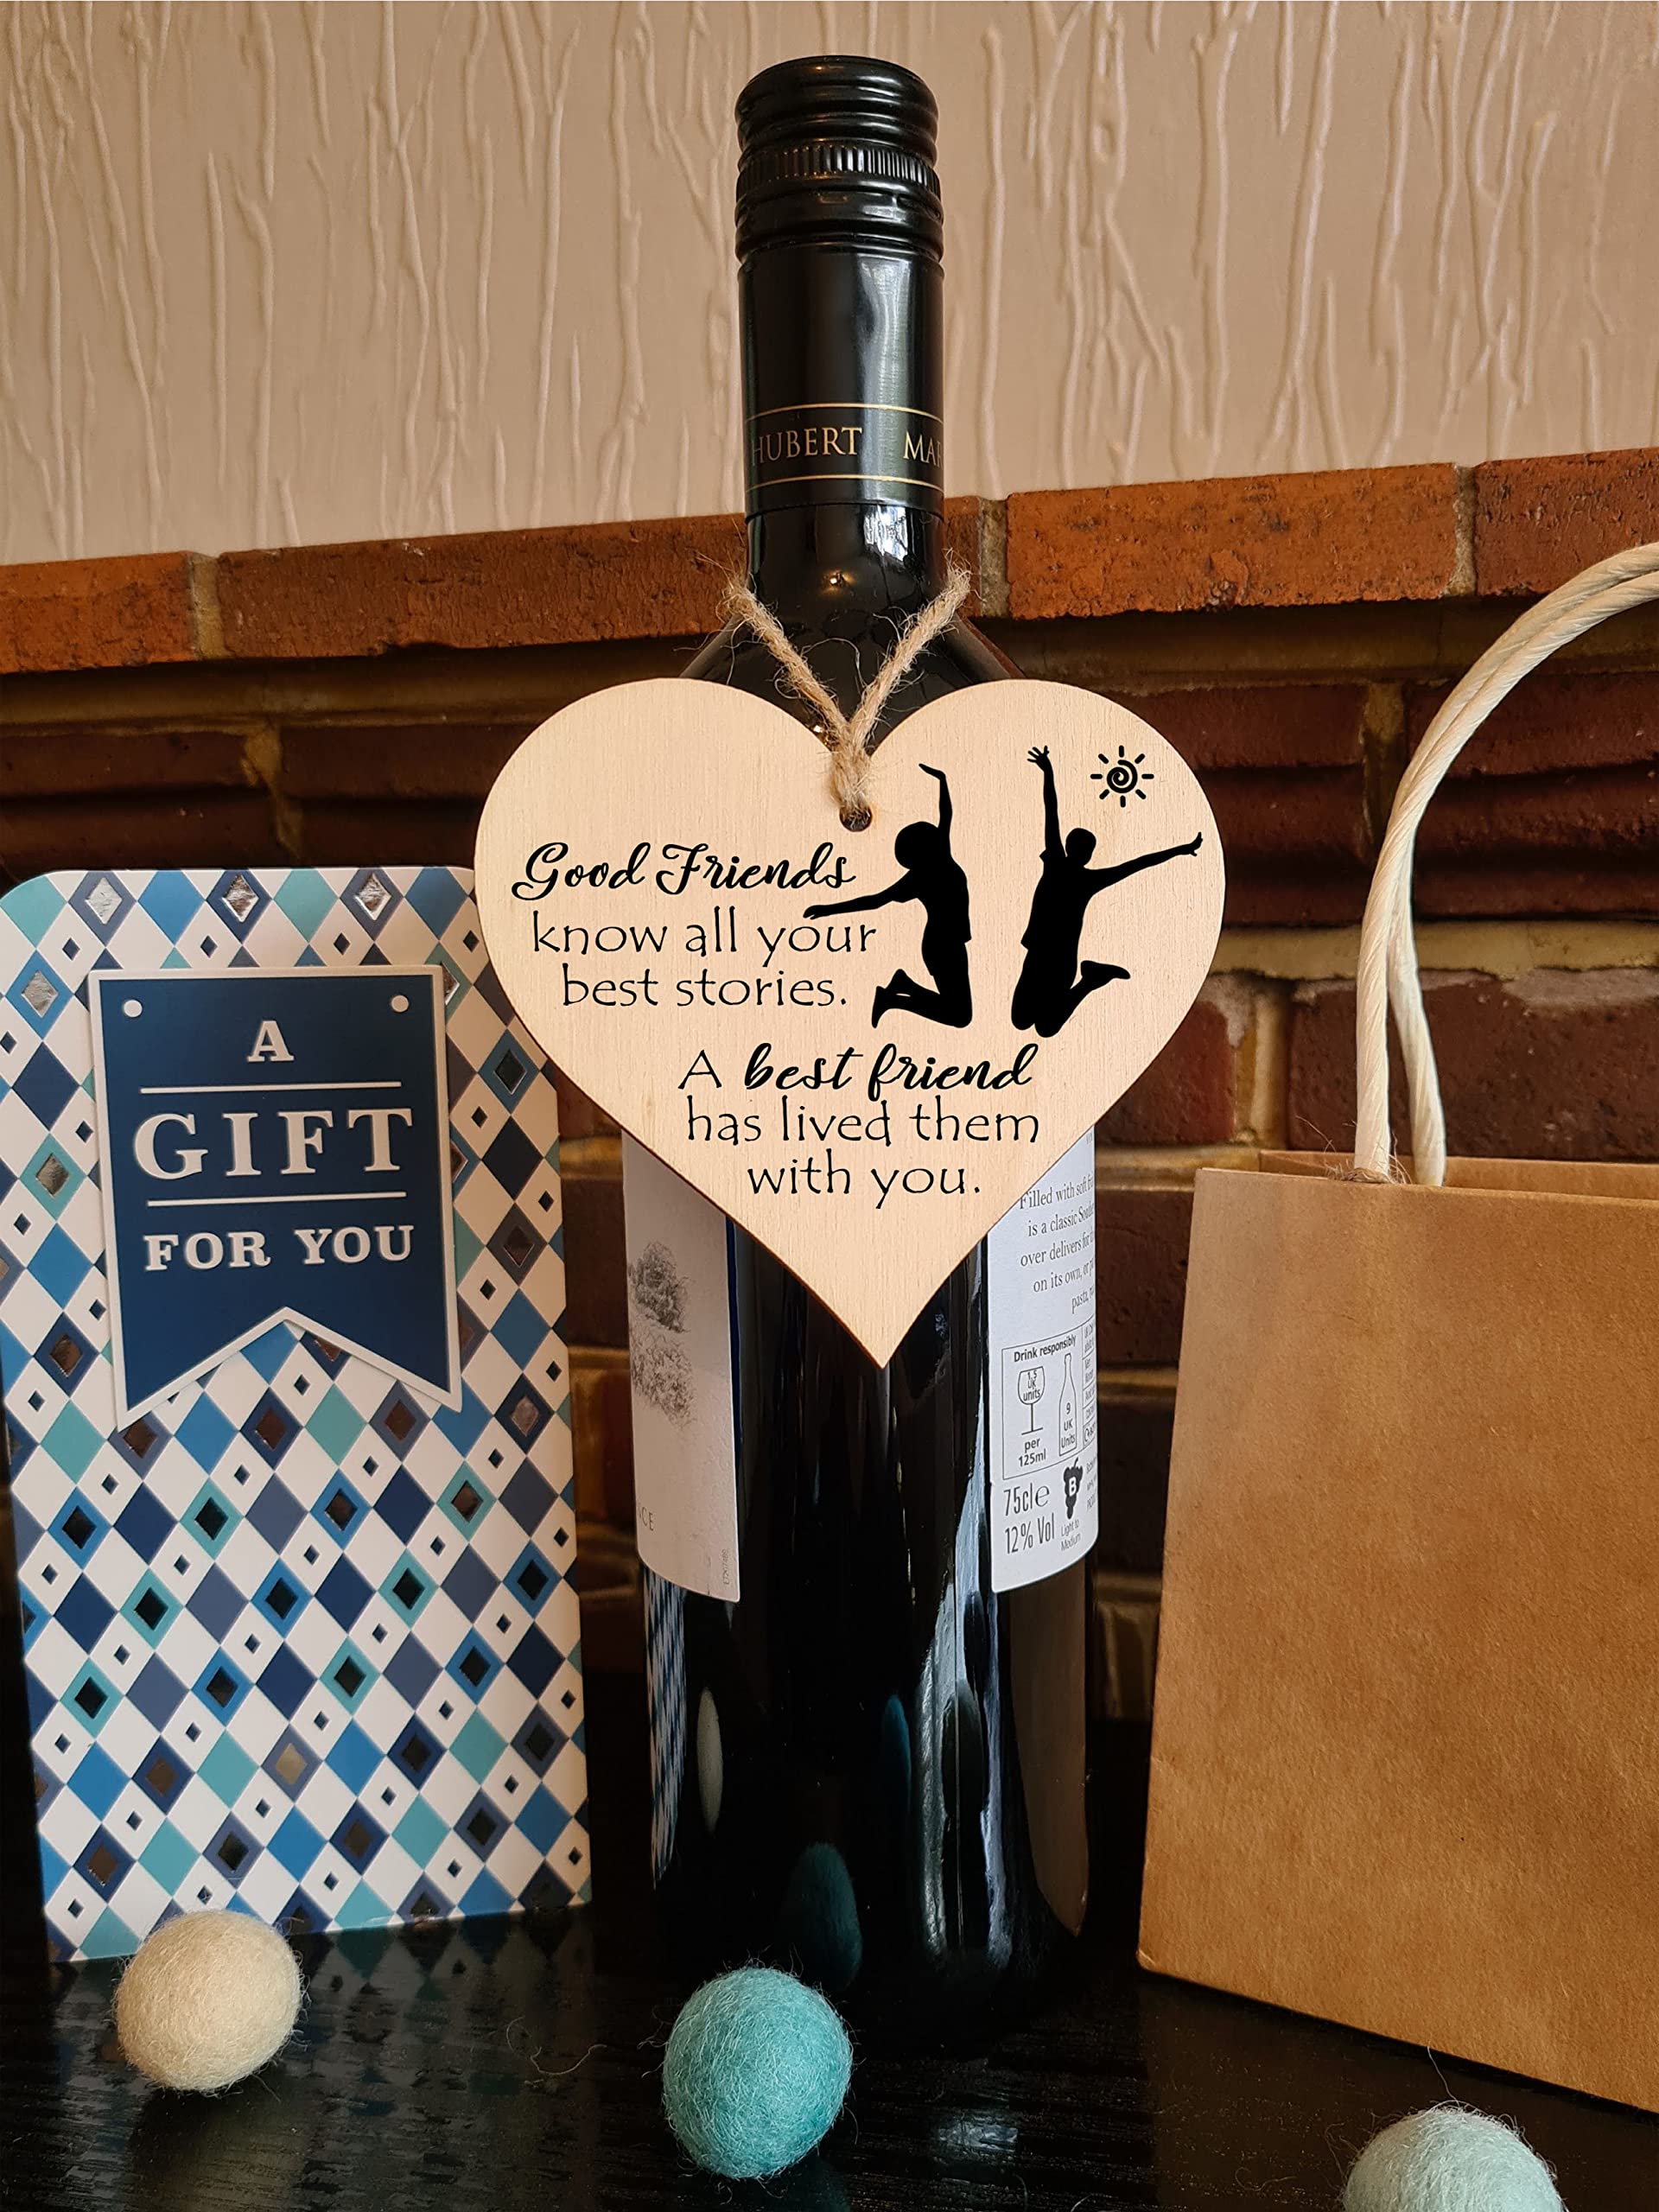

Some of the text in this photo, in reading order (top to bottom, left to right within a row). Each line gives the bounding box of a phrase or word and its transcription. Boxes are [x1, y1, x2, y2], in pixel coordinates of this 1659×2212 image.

[752, 426, 862, 467] HUBERT
[511, 842, 856, 900] Good Friends
[532, 906, 877, 967] know all your
[562, 963, 848, 1007] best stories.
[247, 1020, 295, 1062] A
[677, 1042, 1039, 1102] A best friend
[687, 1095, 1039, 1147] has lived them
[133, 1108, 413, 1180] GIFT
[747, 1147, 981, 1209] with you.
[1020, 1186, 1052, 1210] Filled
[1056, 1181, 1075, 1202] with
[1028, 1219, 1038, 1236] is
[1041, 1222, 1047, 1234] a
[1050, 1209, 1077, 1232] classic
[143, 1225, 415, 1271] FOR YOU
[1020, 1250, 1046, 1267] over
[1049, 1239, 1082, 1261] delivers
[1033, 1279, 1047, 1293] on
[1051, 1271, 1063, 1288] its
[1014, 1346, 1038, 1363] Drink
[1039, 1333, 1077, 1356] responsibly
[1023, 1389, 1041, 1402] units
[1027, 1377, 1037, 1389] UK
[1065, 1402, 1071, 1415] 9
[1064, 1418, 1073, 1432] UK
[1025, 1438, 1040, 1453] per
[1061, 1433, 1076, 1449] Units
[1019, 1448, 1046, 1467] 125ml
[1005, 1512, 1054, 1554] 12% Vol
